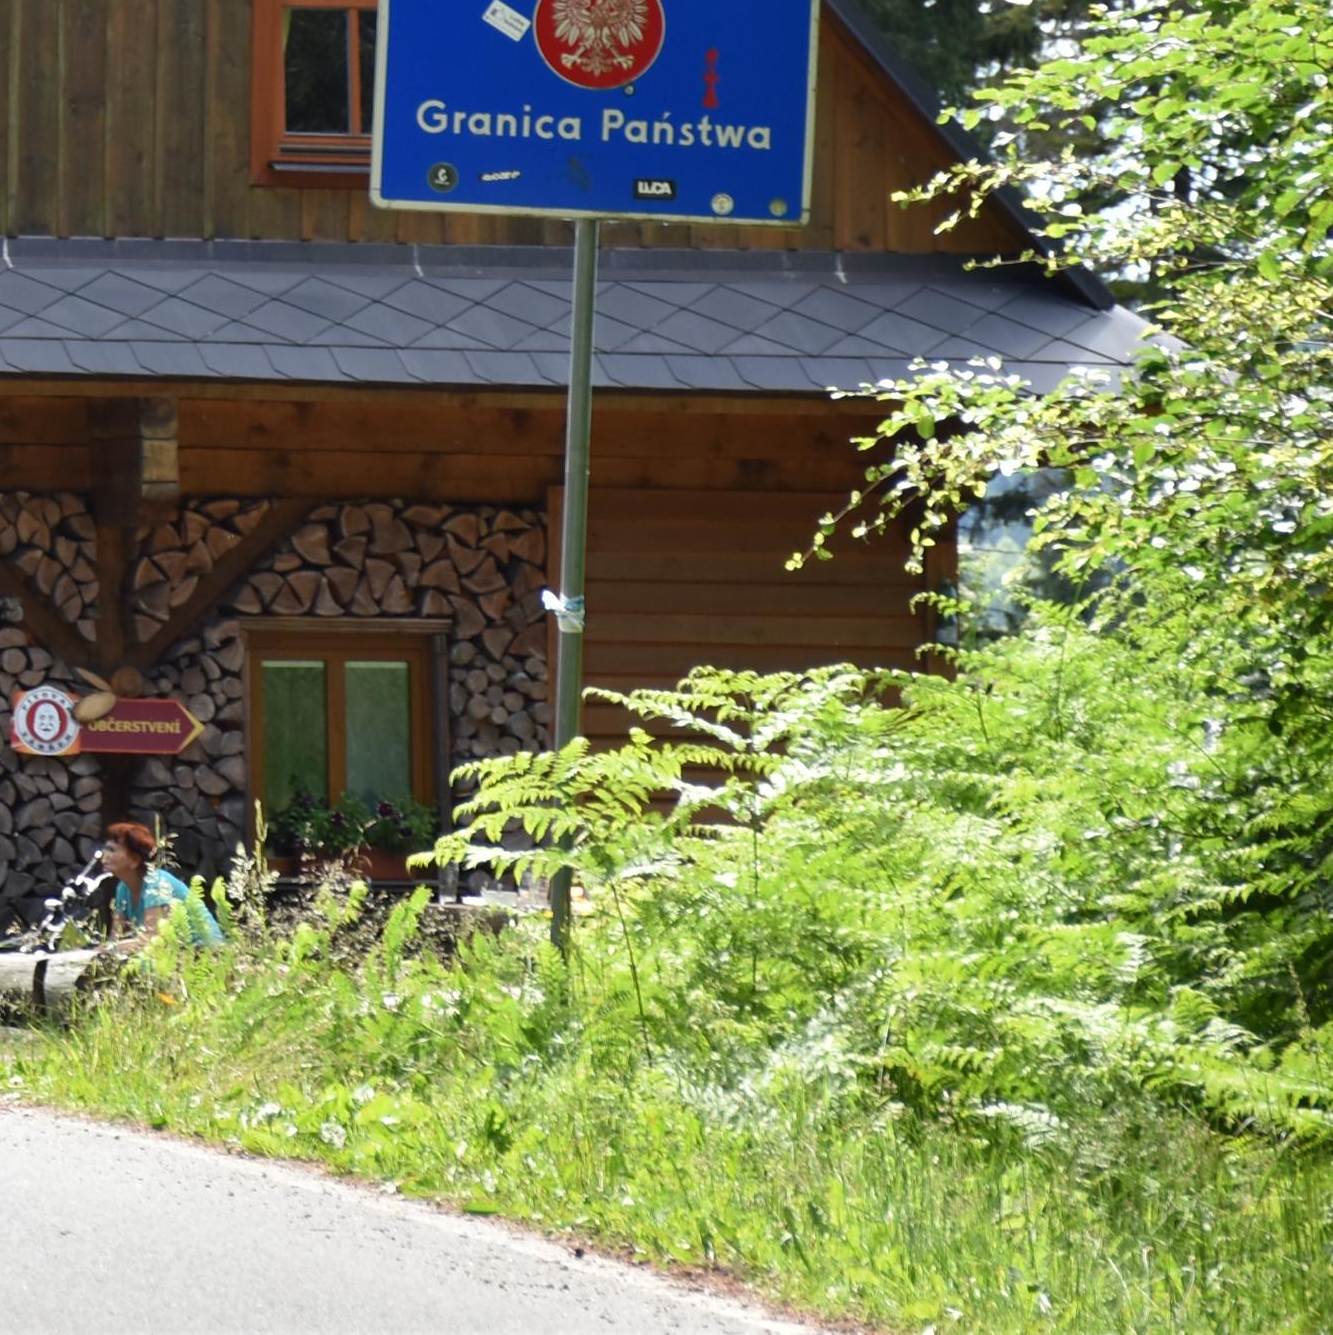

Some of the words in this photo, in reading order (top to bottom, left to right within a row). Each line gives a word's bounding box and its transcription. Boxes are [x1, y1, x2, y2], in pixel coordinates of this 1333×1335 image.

[416, 99, 581, 140] Granica
[601, 108, 772, 150] Państwa
[88, 717, 181, 733] OBČERSTVENÍ
